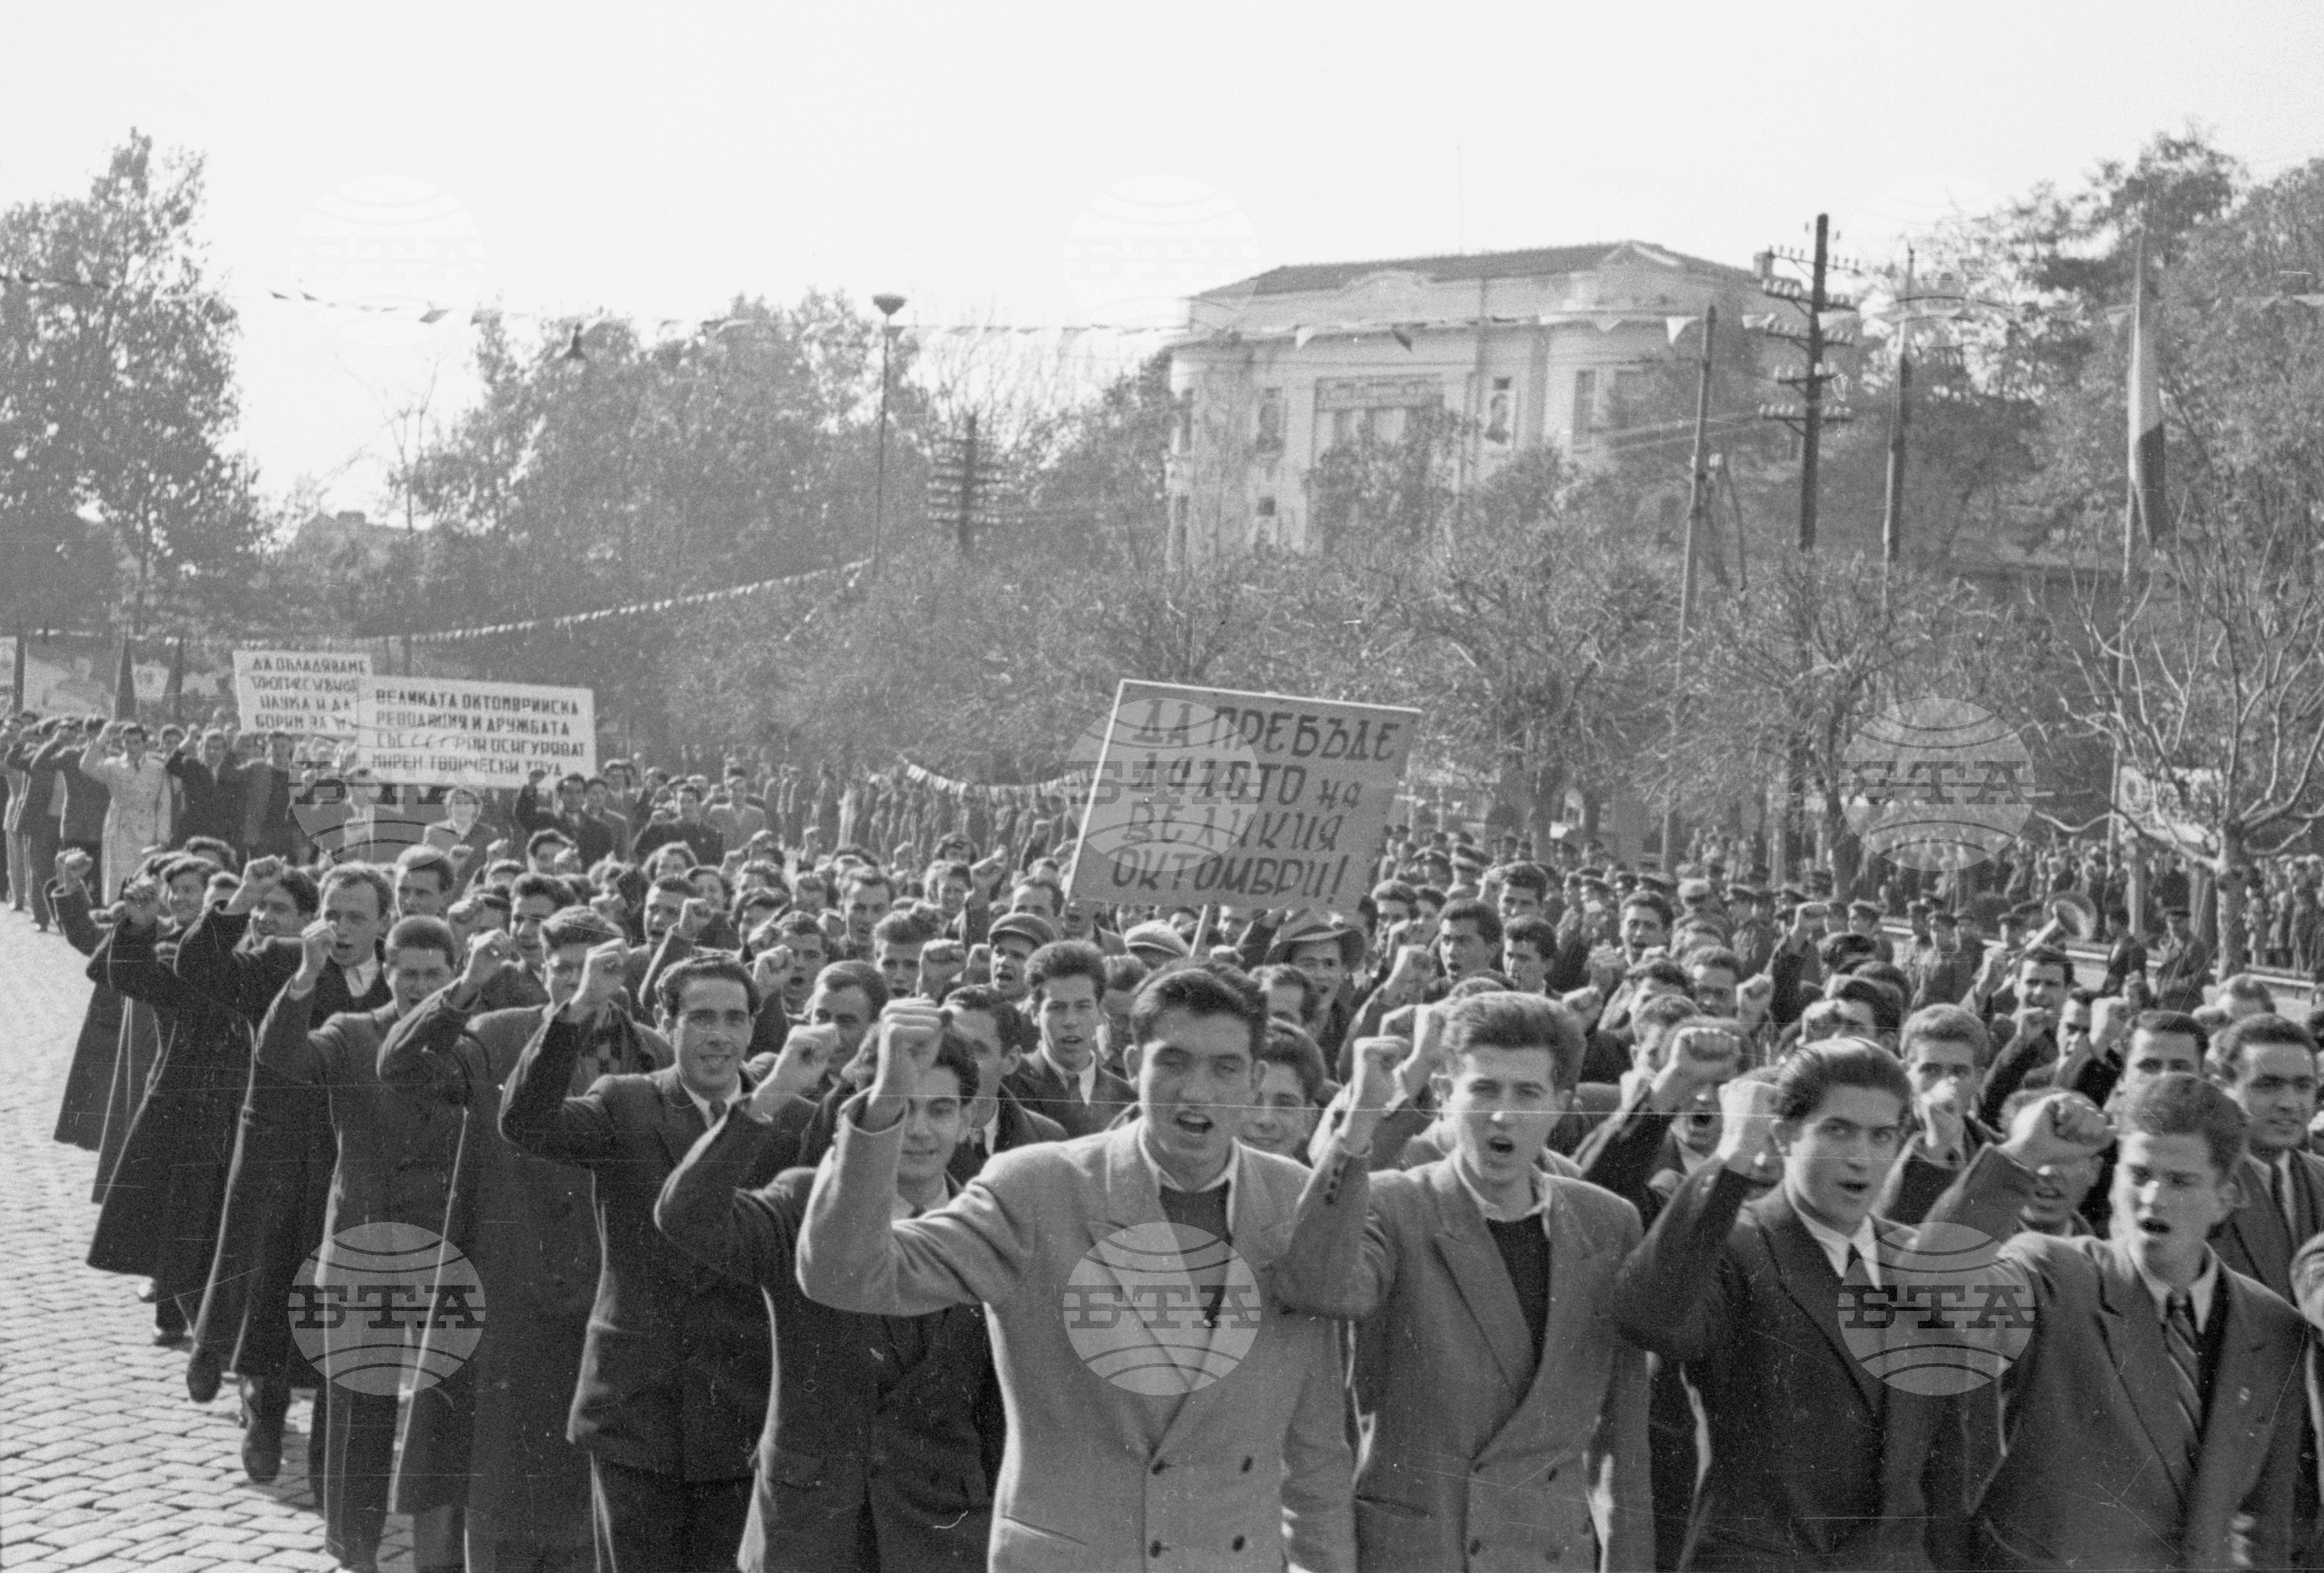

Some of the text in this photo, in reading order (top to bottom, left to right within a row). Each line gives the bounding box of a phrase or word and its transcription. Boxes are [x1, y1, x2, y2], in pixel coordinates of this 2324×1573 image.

[253, 657, 272, 671] ДА
[376, 688, 457, 709] ВЕЛИКАТА
[376, 710, 569, 736] РЕВОЛЮЦИЯ И ДРУЖБАТА
[1132, 700, 1400, 762] ДА ПРЕБЪДЕ
[491, 738, 584, 757] ОСИГУРЯВАТ
[371, 753, 423, 770] МИРЕН
[429, 755, 519, 775] ТВОРЧЕСКИ
[1121, 800, 1343, 852] ВЕЛИКИЯ
[1111, 848, 1350, 905] ОКТОМВРИ!
